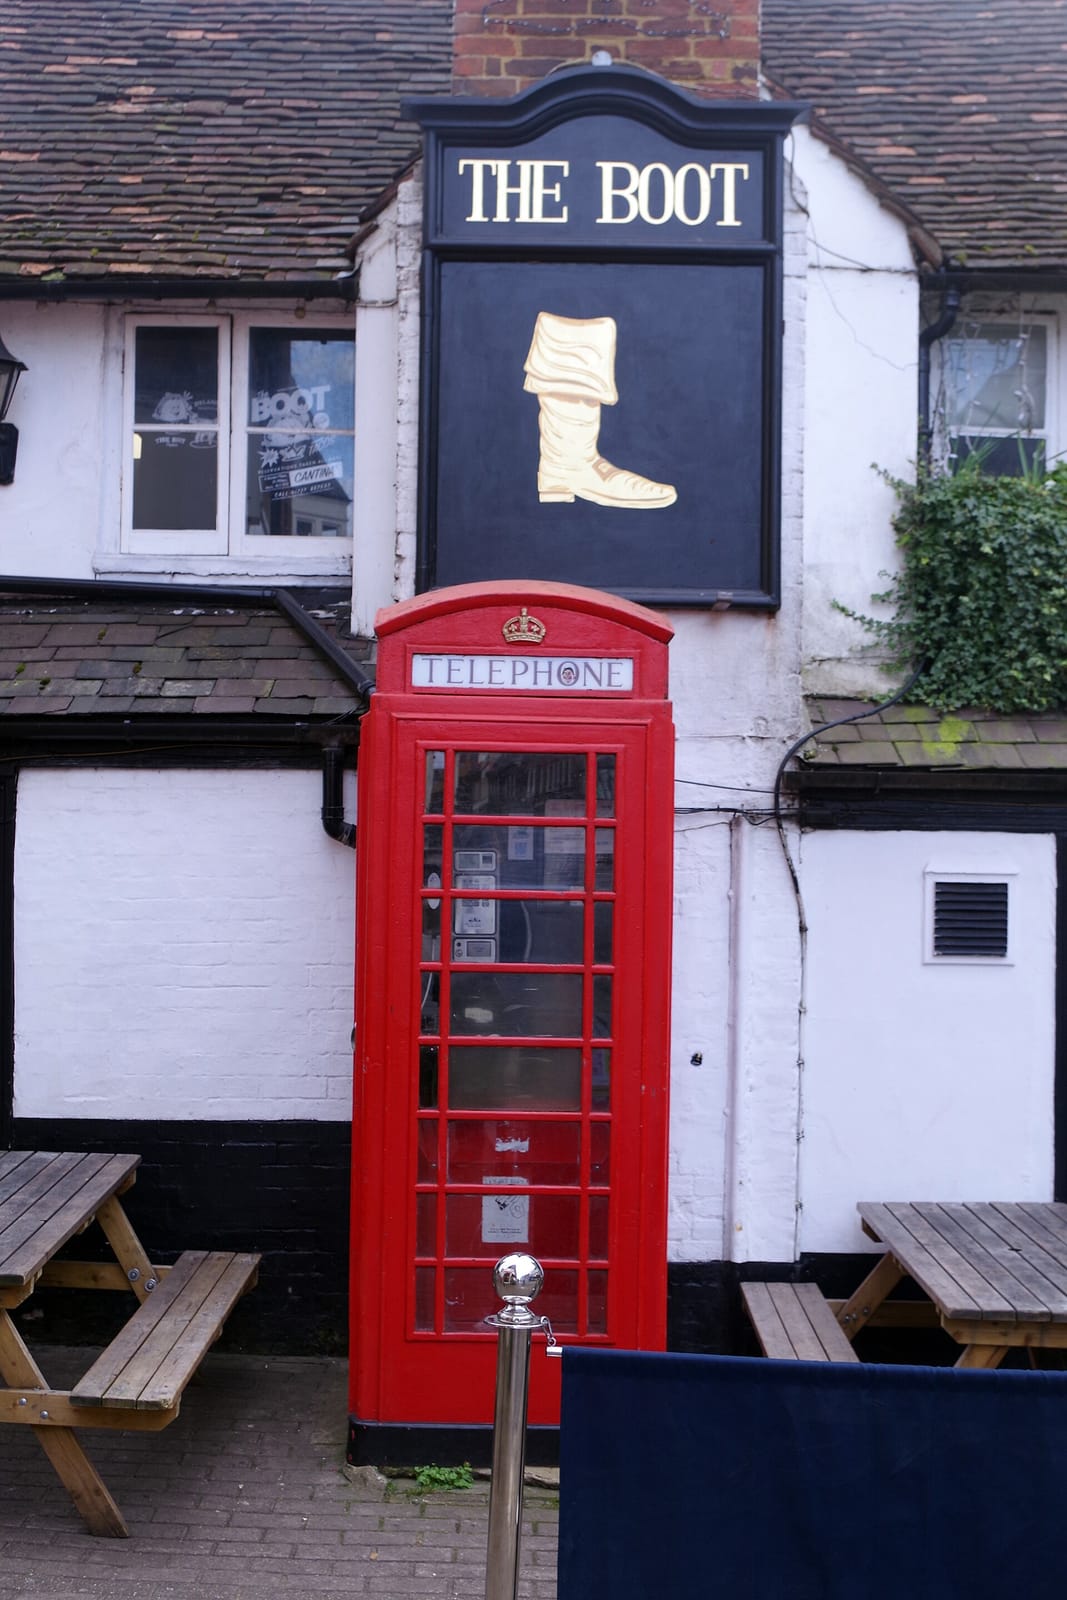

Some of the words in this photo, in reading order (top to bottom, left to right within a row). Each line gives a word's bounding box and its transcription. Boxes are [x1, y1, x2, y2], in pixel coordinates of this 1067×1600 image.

[459, 159, 569, 223] THE
[596, 161, 749, 226] BOOT
[421, 657, 624, 688] TELEPHONE
